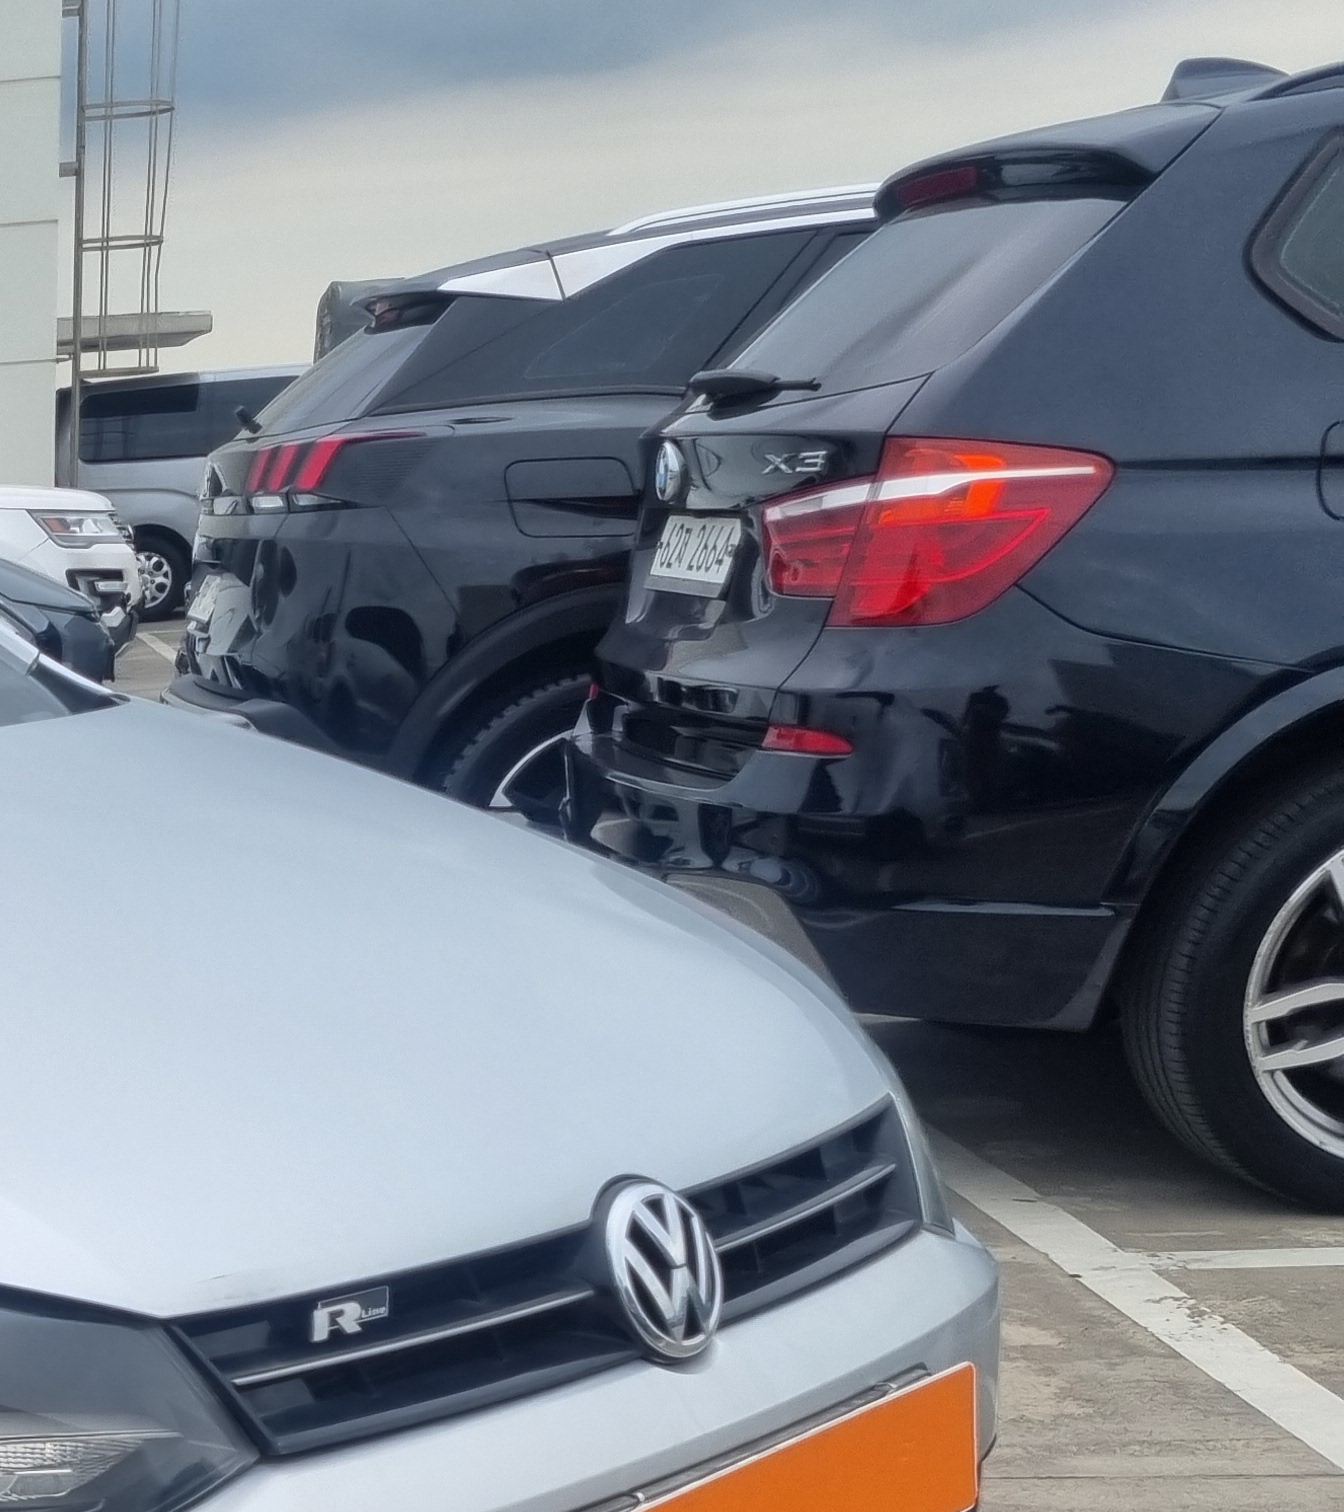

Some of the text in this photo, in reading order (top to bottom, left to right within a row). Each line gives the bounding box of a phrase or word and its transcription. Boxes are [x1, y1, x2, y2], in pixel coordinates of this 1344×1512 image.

[761, 450, 828, 475] X3
[686, 524, 734, 574] 2664
[312, 1302, 362, 1342] R
